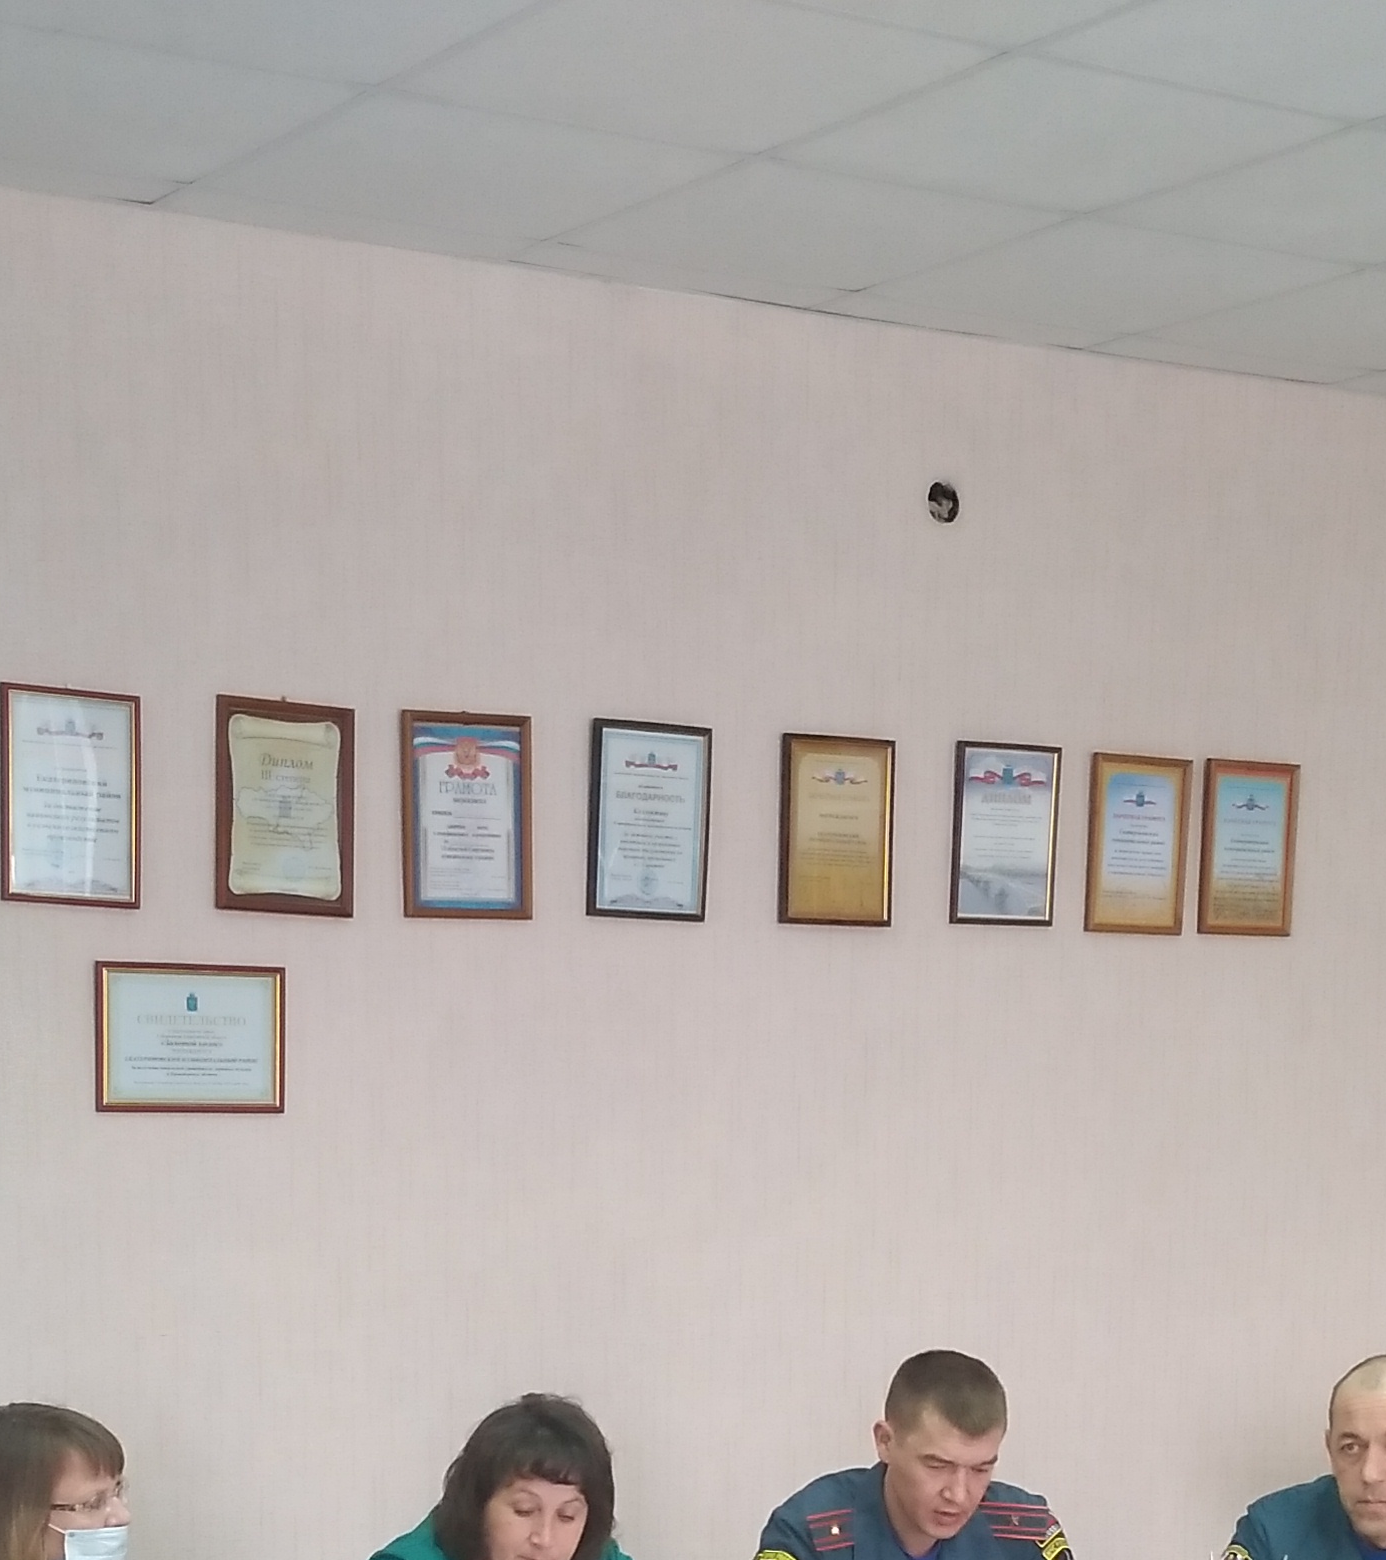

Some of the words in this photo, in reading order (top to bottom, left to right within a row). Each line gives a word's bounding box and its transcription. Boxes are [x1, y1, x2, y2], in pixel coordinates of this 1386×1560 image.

[261, 753, 313, 770] Диплом
[439, 781, 497, 796] ГРАМОТА
[616, 790, 685, 803] БЛАГОДАРНОСТЬ
